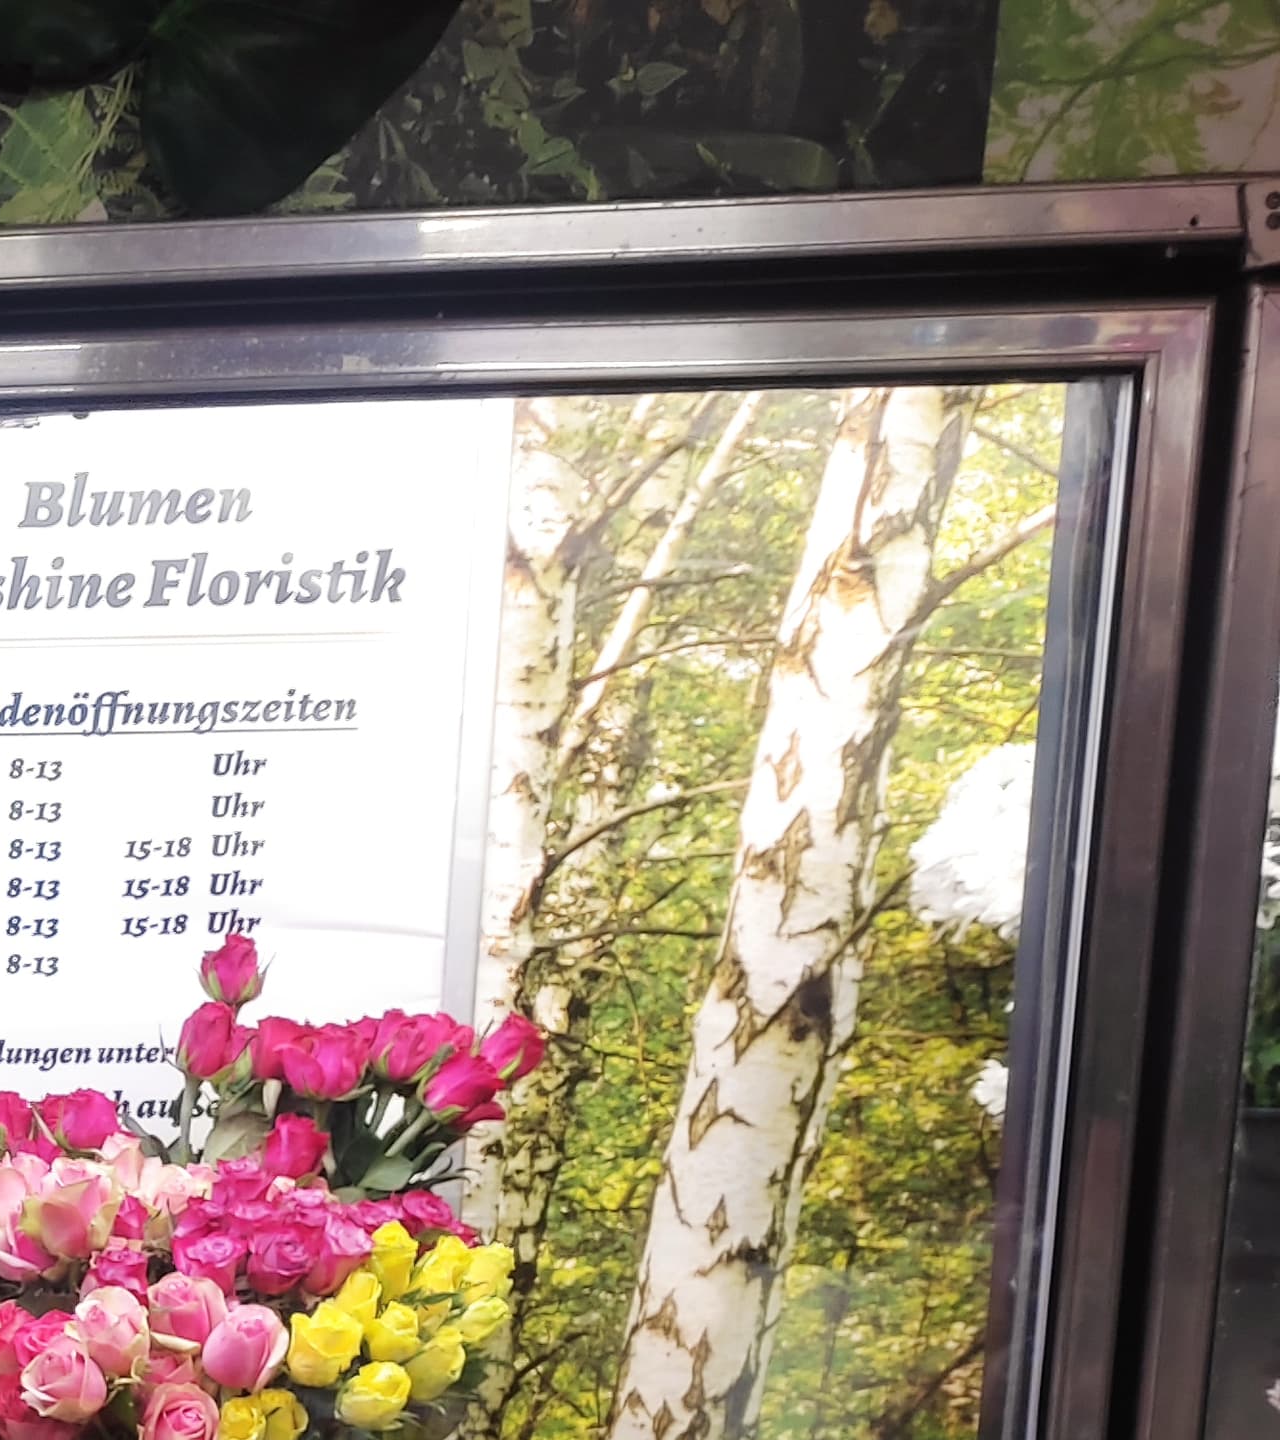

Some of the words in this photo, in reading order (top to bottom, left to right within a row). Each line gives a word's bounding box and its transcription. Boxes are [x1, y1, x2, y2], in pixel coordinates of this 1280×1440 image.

[17, 471, 253, 528] Blumen
[143, 548, 406, 608] Floristik
[8, 757, 63, 782] 8-13
[212, 750, 268, 777] Uhr
[8, 799, 62, 824] 8-13
[211, 792, 265, 818] Uhr
[8, 838, 62, 862] 8-13
[124, 836, 192, 861] 15-18
[211, 830, 265, 857] Uhr
[6, 876, 61, 901] 8-13
[122, 875, 190, 900] 15-18
[209, 870, 264, 897] Uhr
[5, 915, 59, 940] 8-13
[120, 913, 189, 938] 15-18
[207, 908, 262, 935] Uhr
[5, 953, 59, 977] 8-13
[97, 1042, 176, 1064] unter
